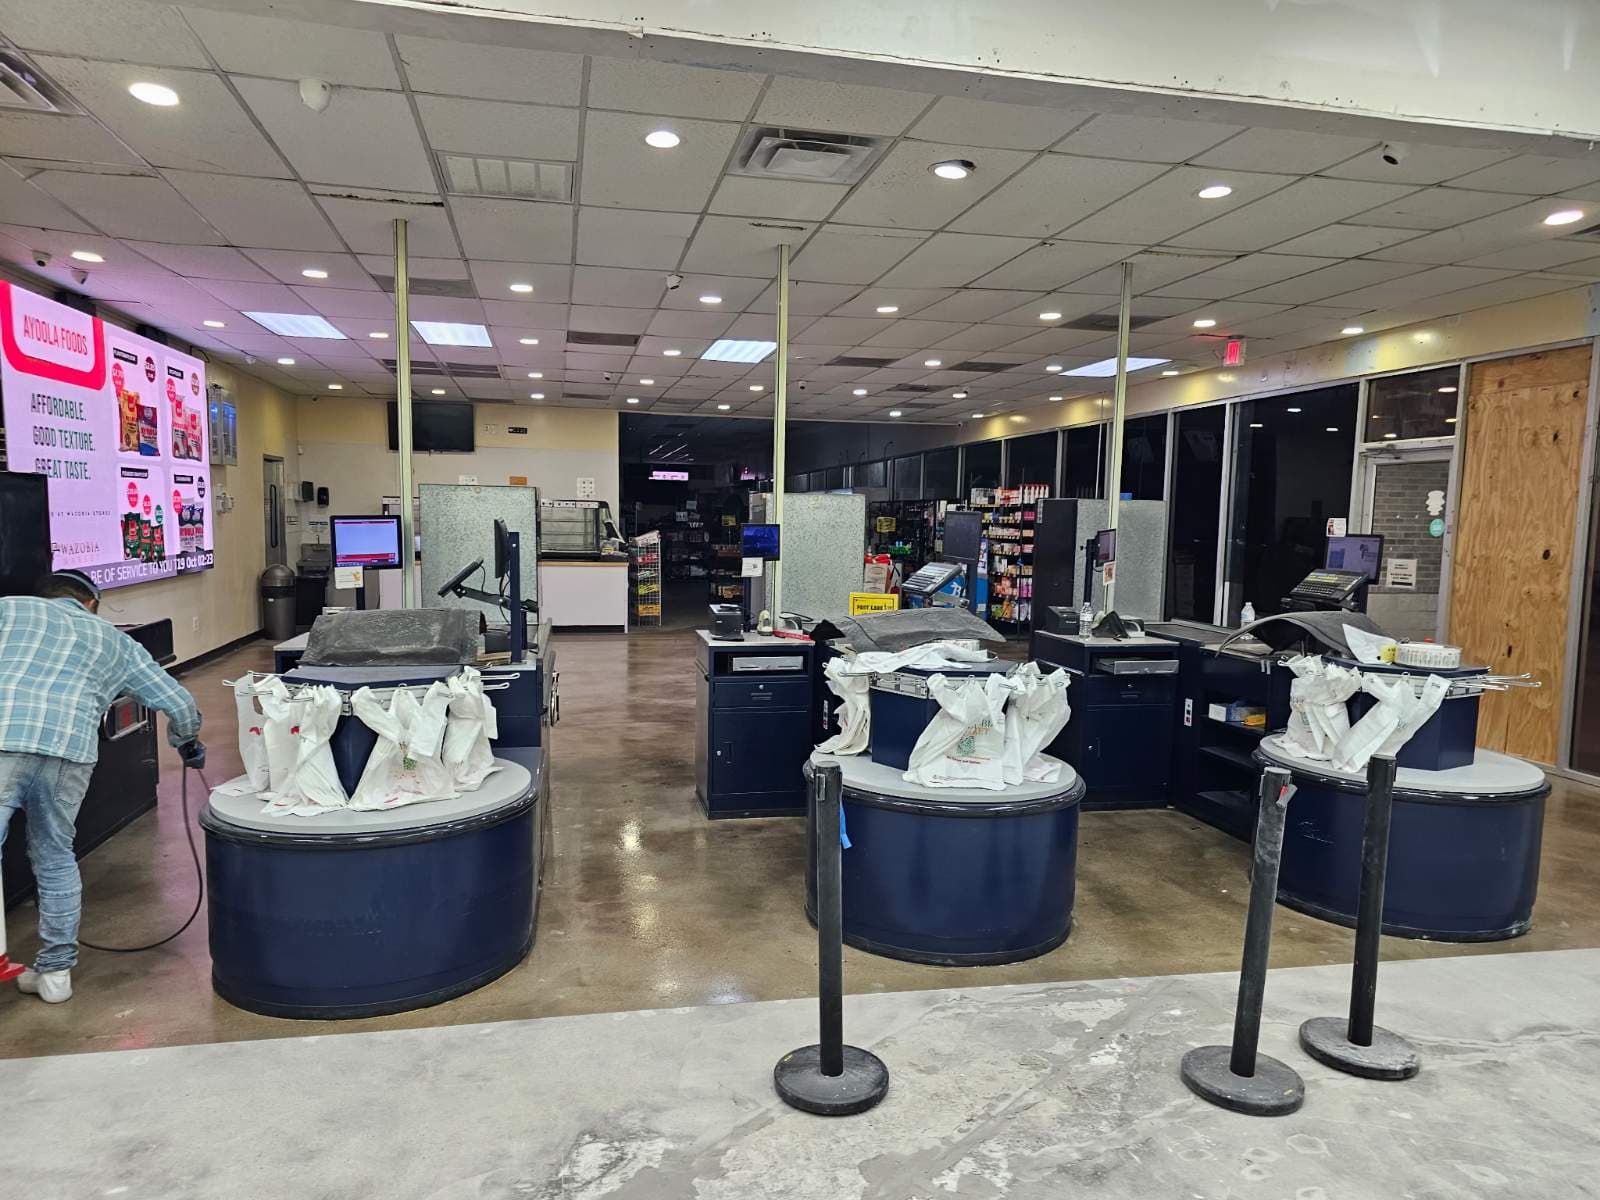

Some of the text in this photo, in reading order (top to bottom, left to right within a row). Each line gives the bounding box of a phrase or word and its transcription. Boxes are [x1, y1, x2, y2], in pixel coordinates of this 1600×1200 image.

[24, 315, 59, 347] AYOOLA
[61, 328, 88, 355] FOODS
[31, 393, 87, 421] AFFORDABLE.
[33, 426, 96, 451] GOOD TEXTURE.
[64, 460, 91, 479] TASTE.
[91, 570, 103, 585] BE
[104, 568, 116, 583] OF
[117, 564, 148, 581] SERVICE
[149, 562, 158, 575] TO
[159, 560, 173, 573] YOU
[177, 557, 185, 570] 19
[186, 556, 197, 569] Oct
[198, 553, 214, 566] 02:23
